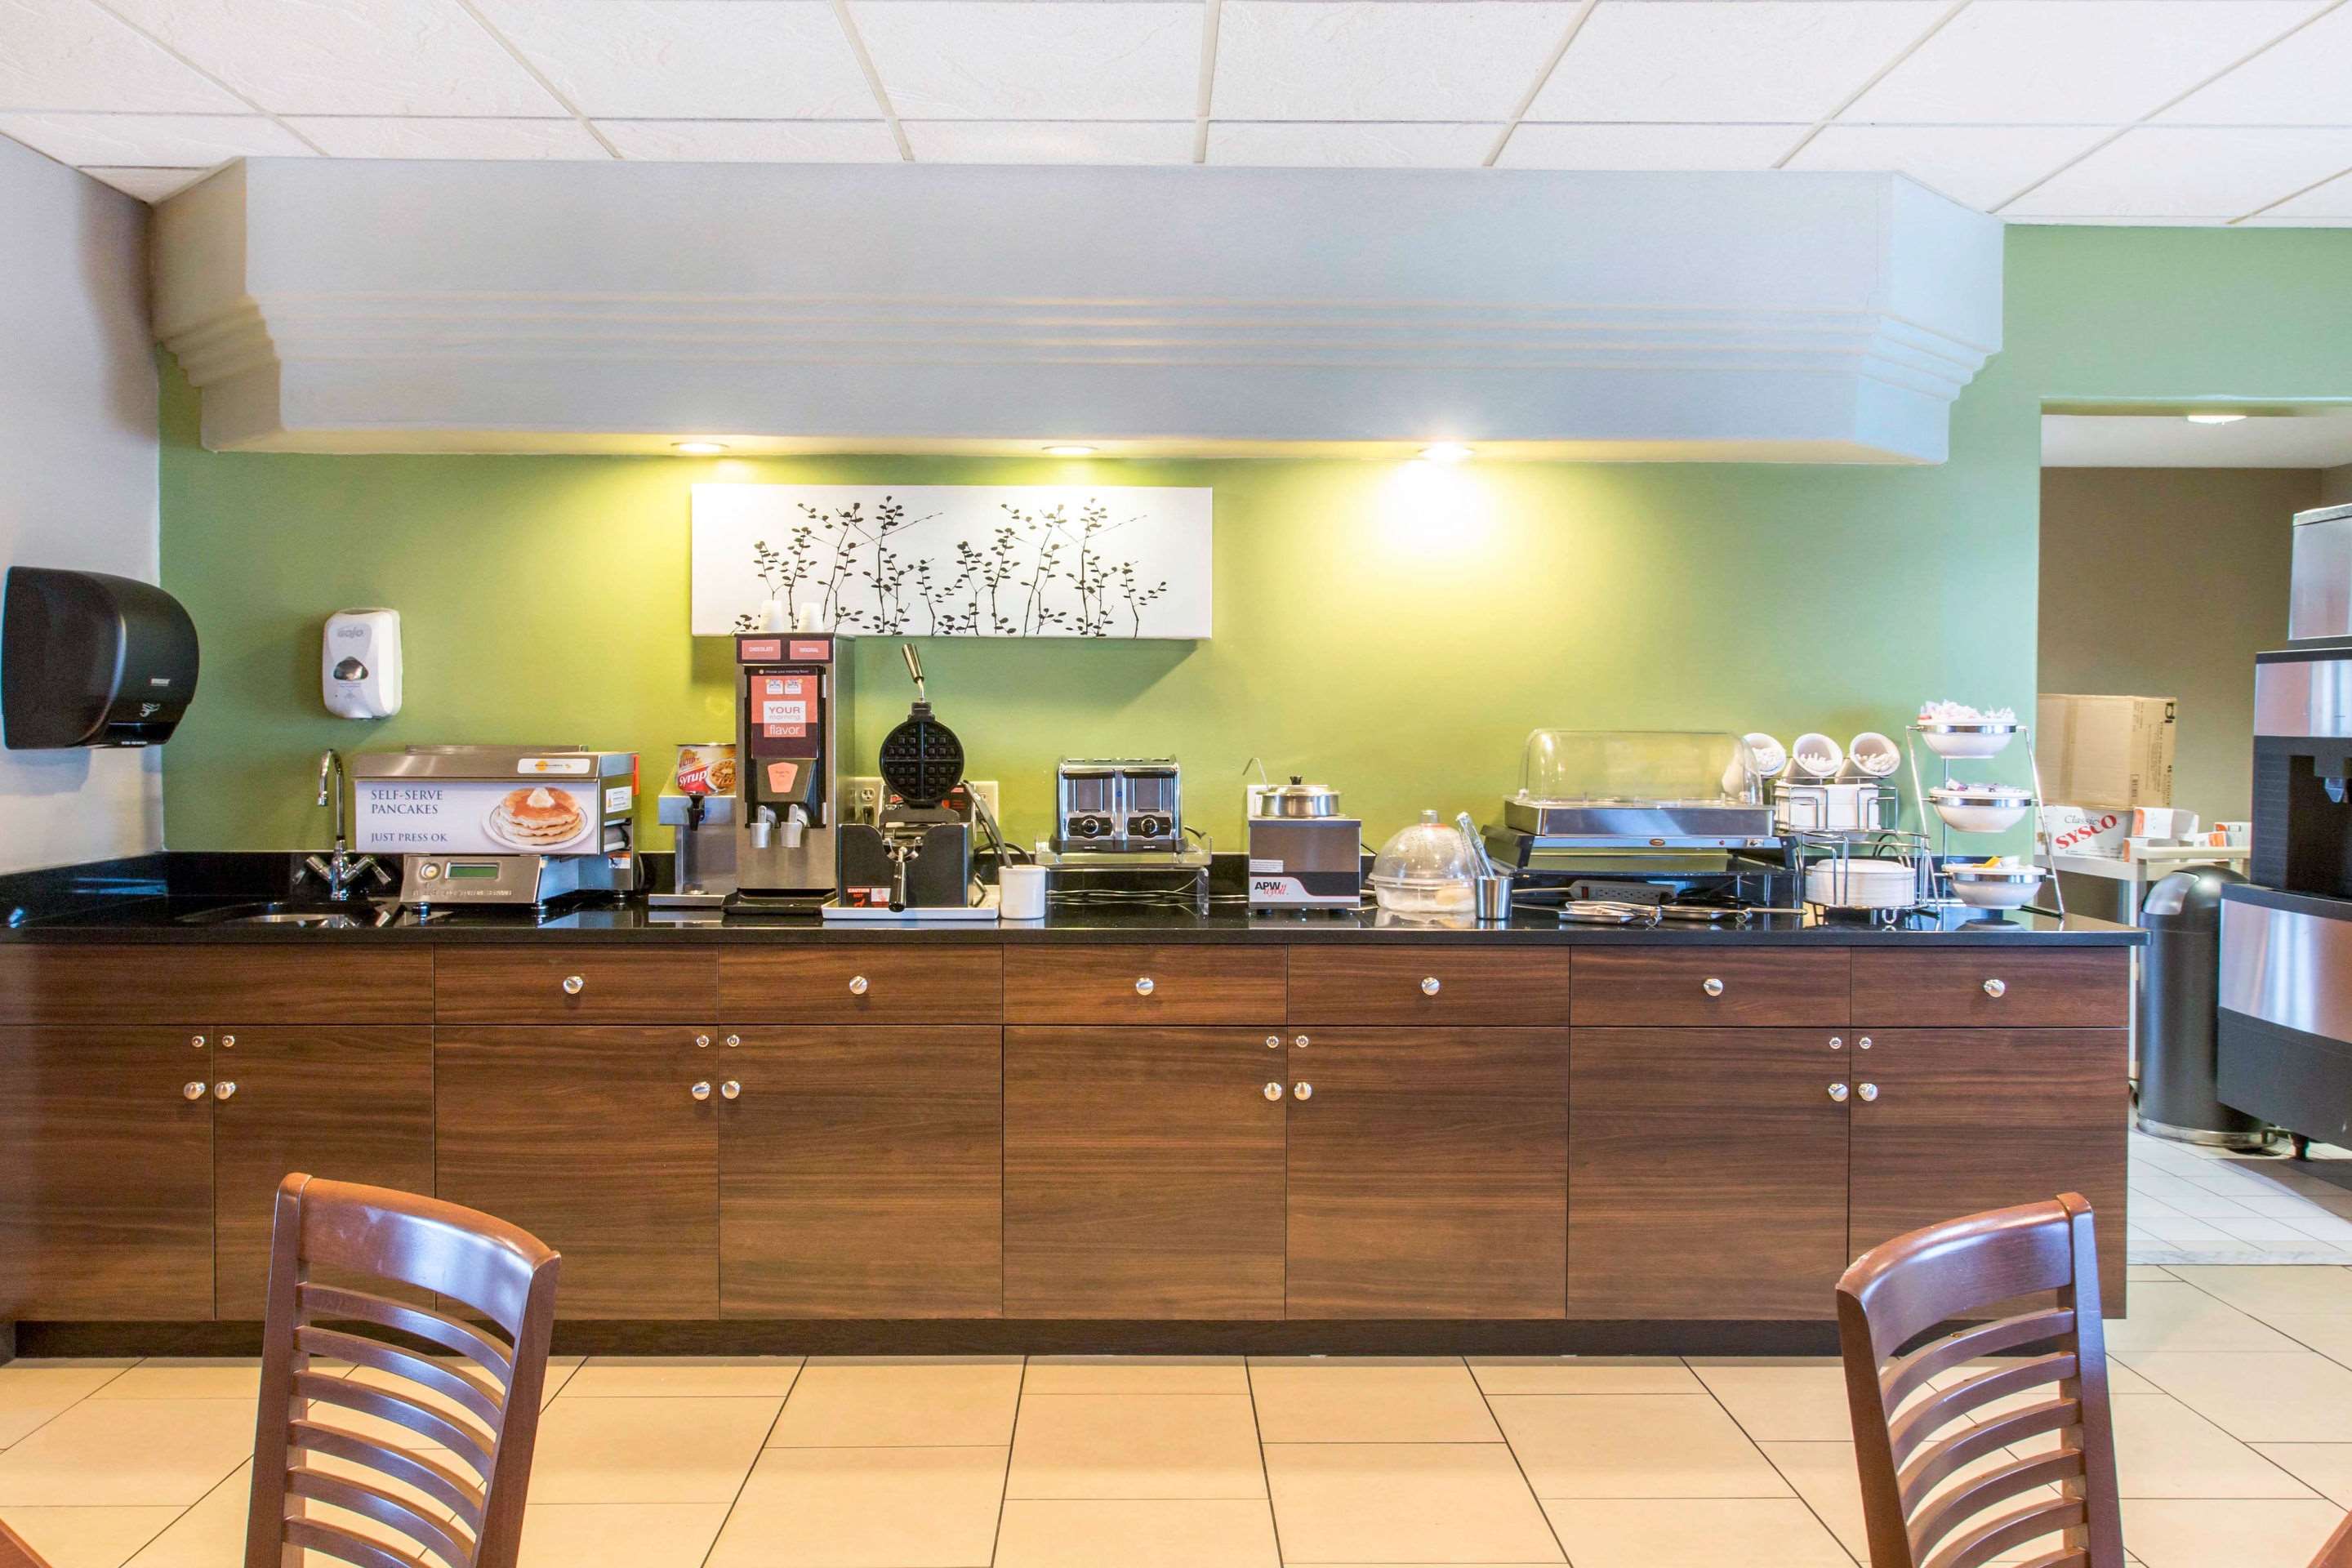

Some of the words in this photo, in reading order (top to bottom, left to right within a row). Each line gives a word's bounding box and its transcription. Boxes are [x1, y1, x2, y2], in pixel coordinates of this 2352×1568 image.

[769, 724, 800, 736] flavor
[679, 770, 707, 786] Syrup
[371, 790, 443, 800] SELF-SERVE
[371, 804, 439, 814] PANCAKES
[2055, 814, 2118, 849] SYSCO
[371, 832, 394, 843] JUST
[398, 832, 428, 842] PRESS
[430, 832, 448, 842] OK
[1254, 882, 1281, 890] APW
